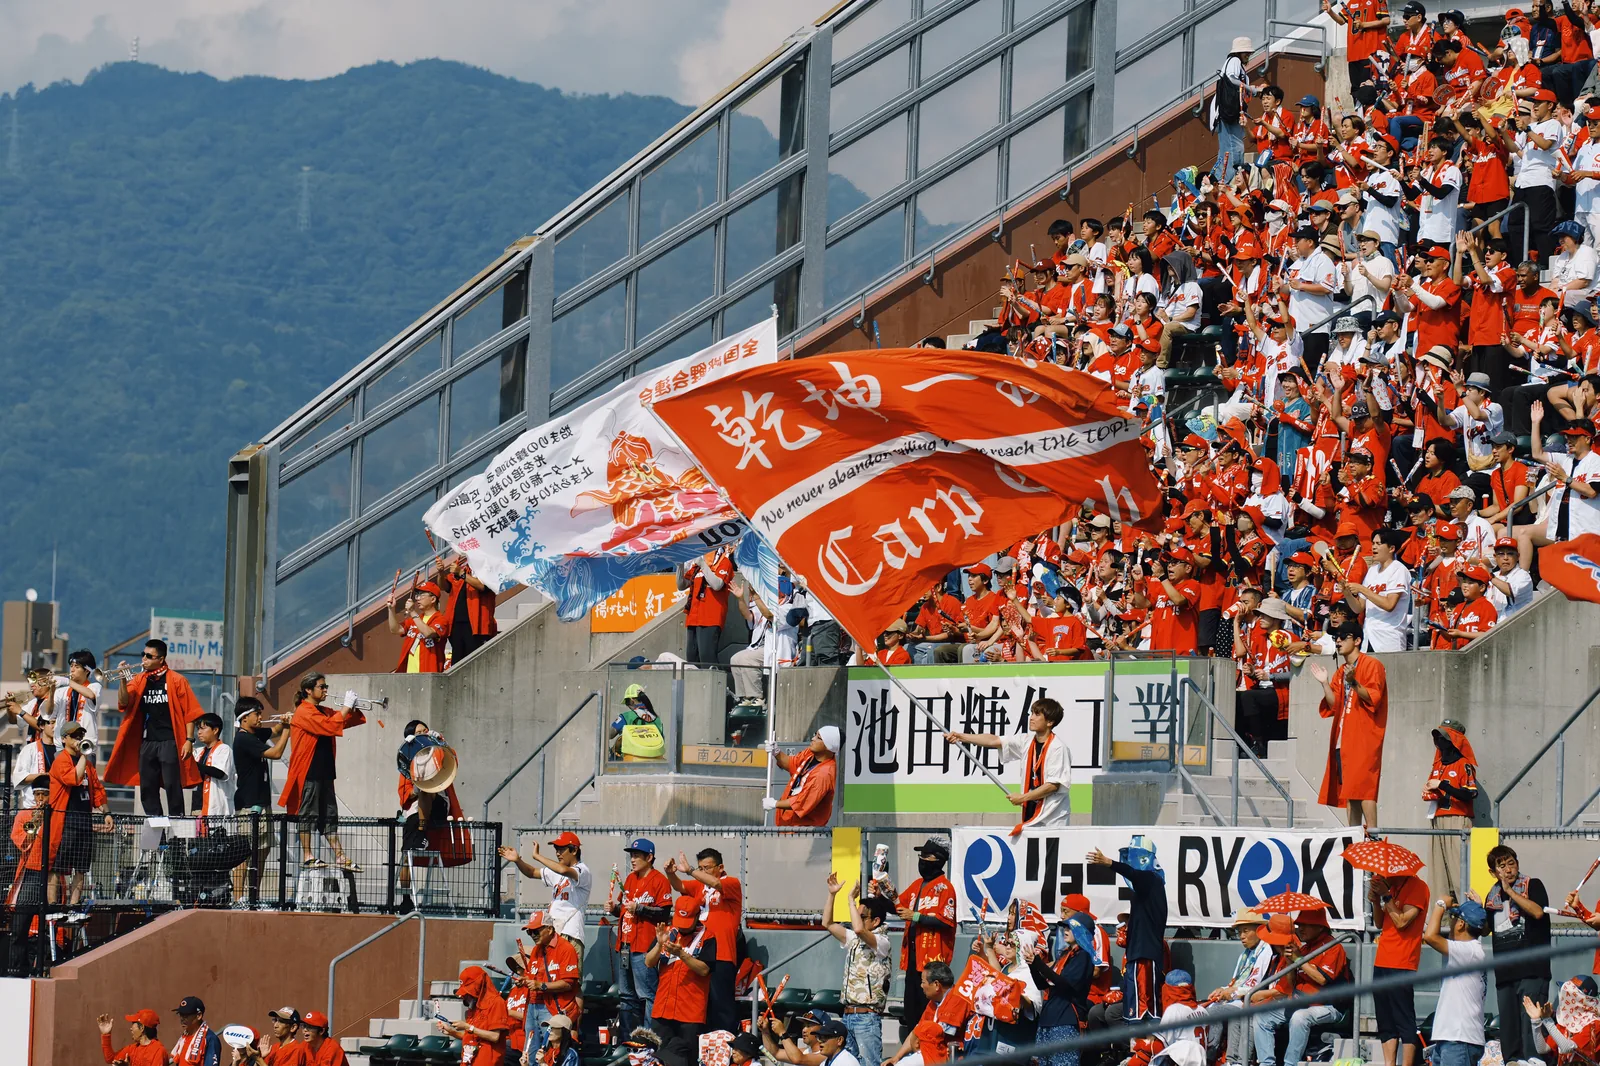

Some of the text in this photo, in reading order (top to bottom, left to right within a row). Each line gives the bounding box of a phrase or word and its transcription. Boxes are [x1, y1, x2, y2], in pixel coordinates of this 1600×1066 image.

[704, 358, 1041, 470] 乾坤一
[760, 510, 785, 532] We
[787, 484, 825, 513] never
[989, 440, 1034, 457] reach
[1039, 434, 1079, 452] THE
[1085, 418, 1131, 444] TOP!
[817, 482, 986, 596] Carp
[697, 748, 738, 764] 南 240
[1025, 834, 1147, 914] リョー
